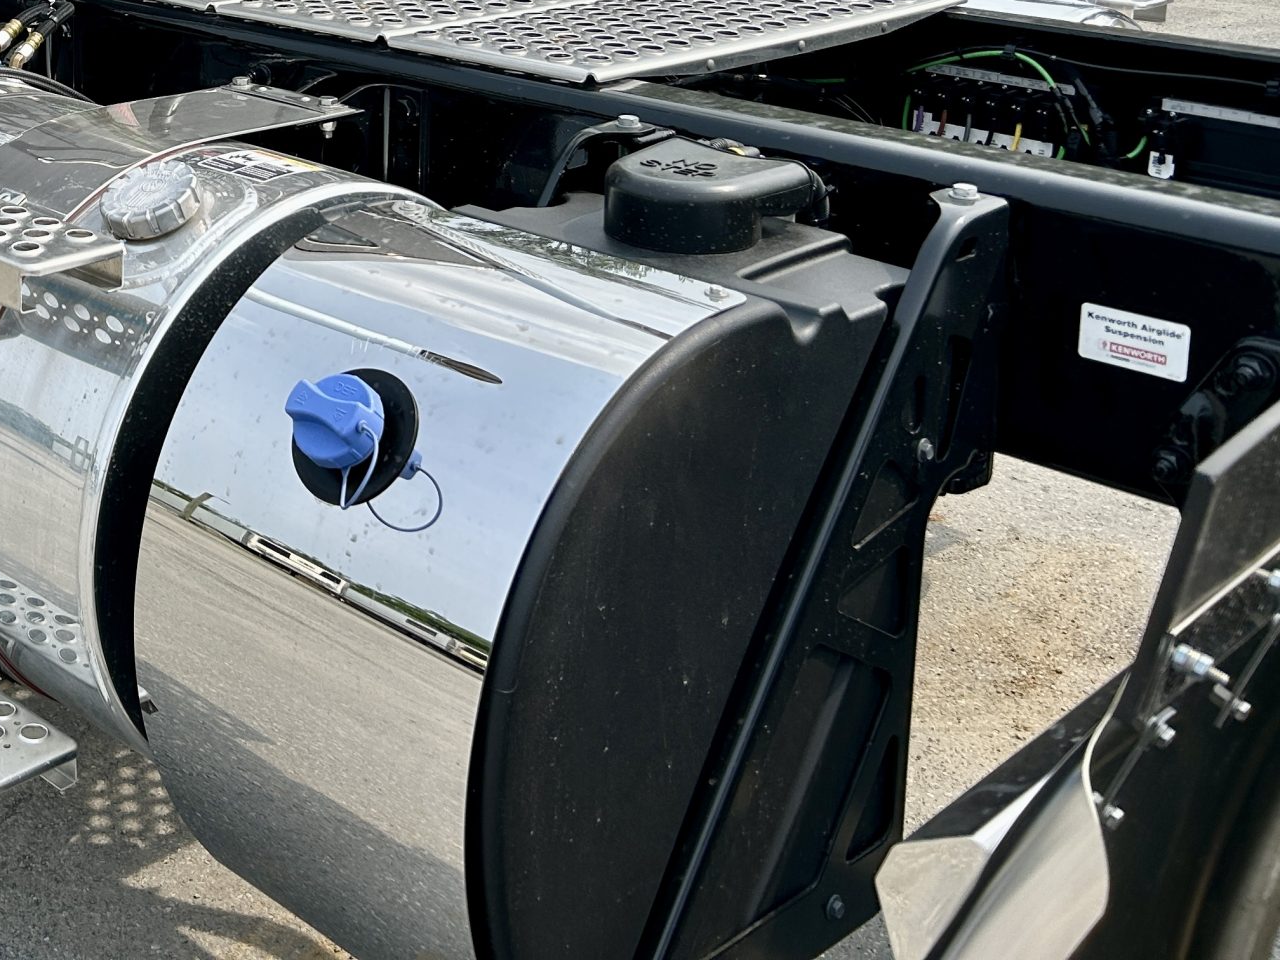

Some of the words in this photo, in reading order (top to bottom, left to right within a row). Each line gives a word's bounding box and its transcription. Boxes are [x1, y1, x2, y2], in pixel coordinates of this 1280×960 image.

[672, 159, 718, 171] NO
[1087, 311, 1138, 329] Kenworth
[1141, 324, 1182, 339] Airglide
[1104, 326, 1165, 345] Suspension
[1111, 342, 1166, 364] KENWORTH
